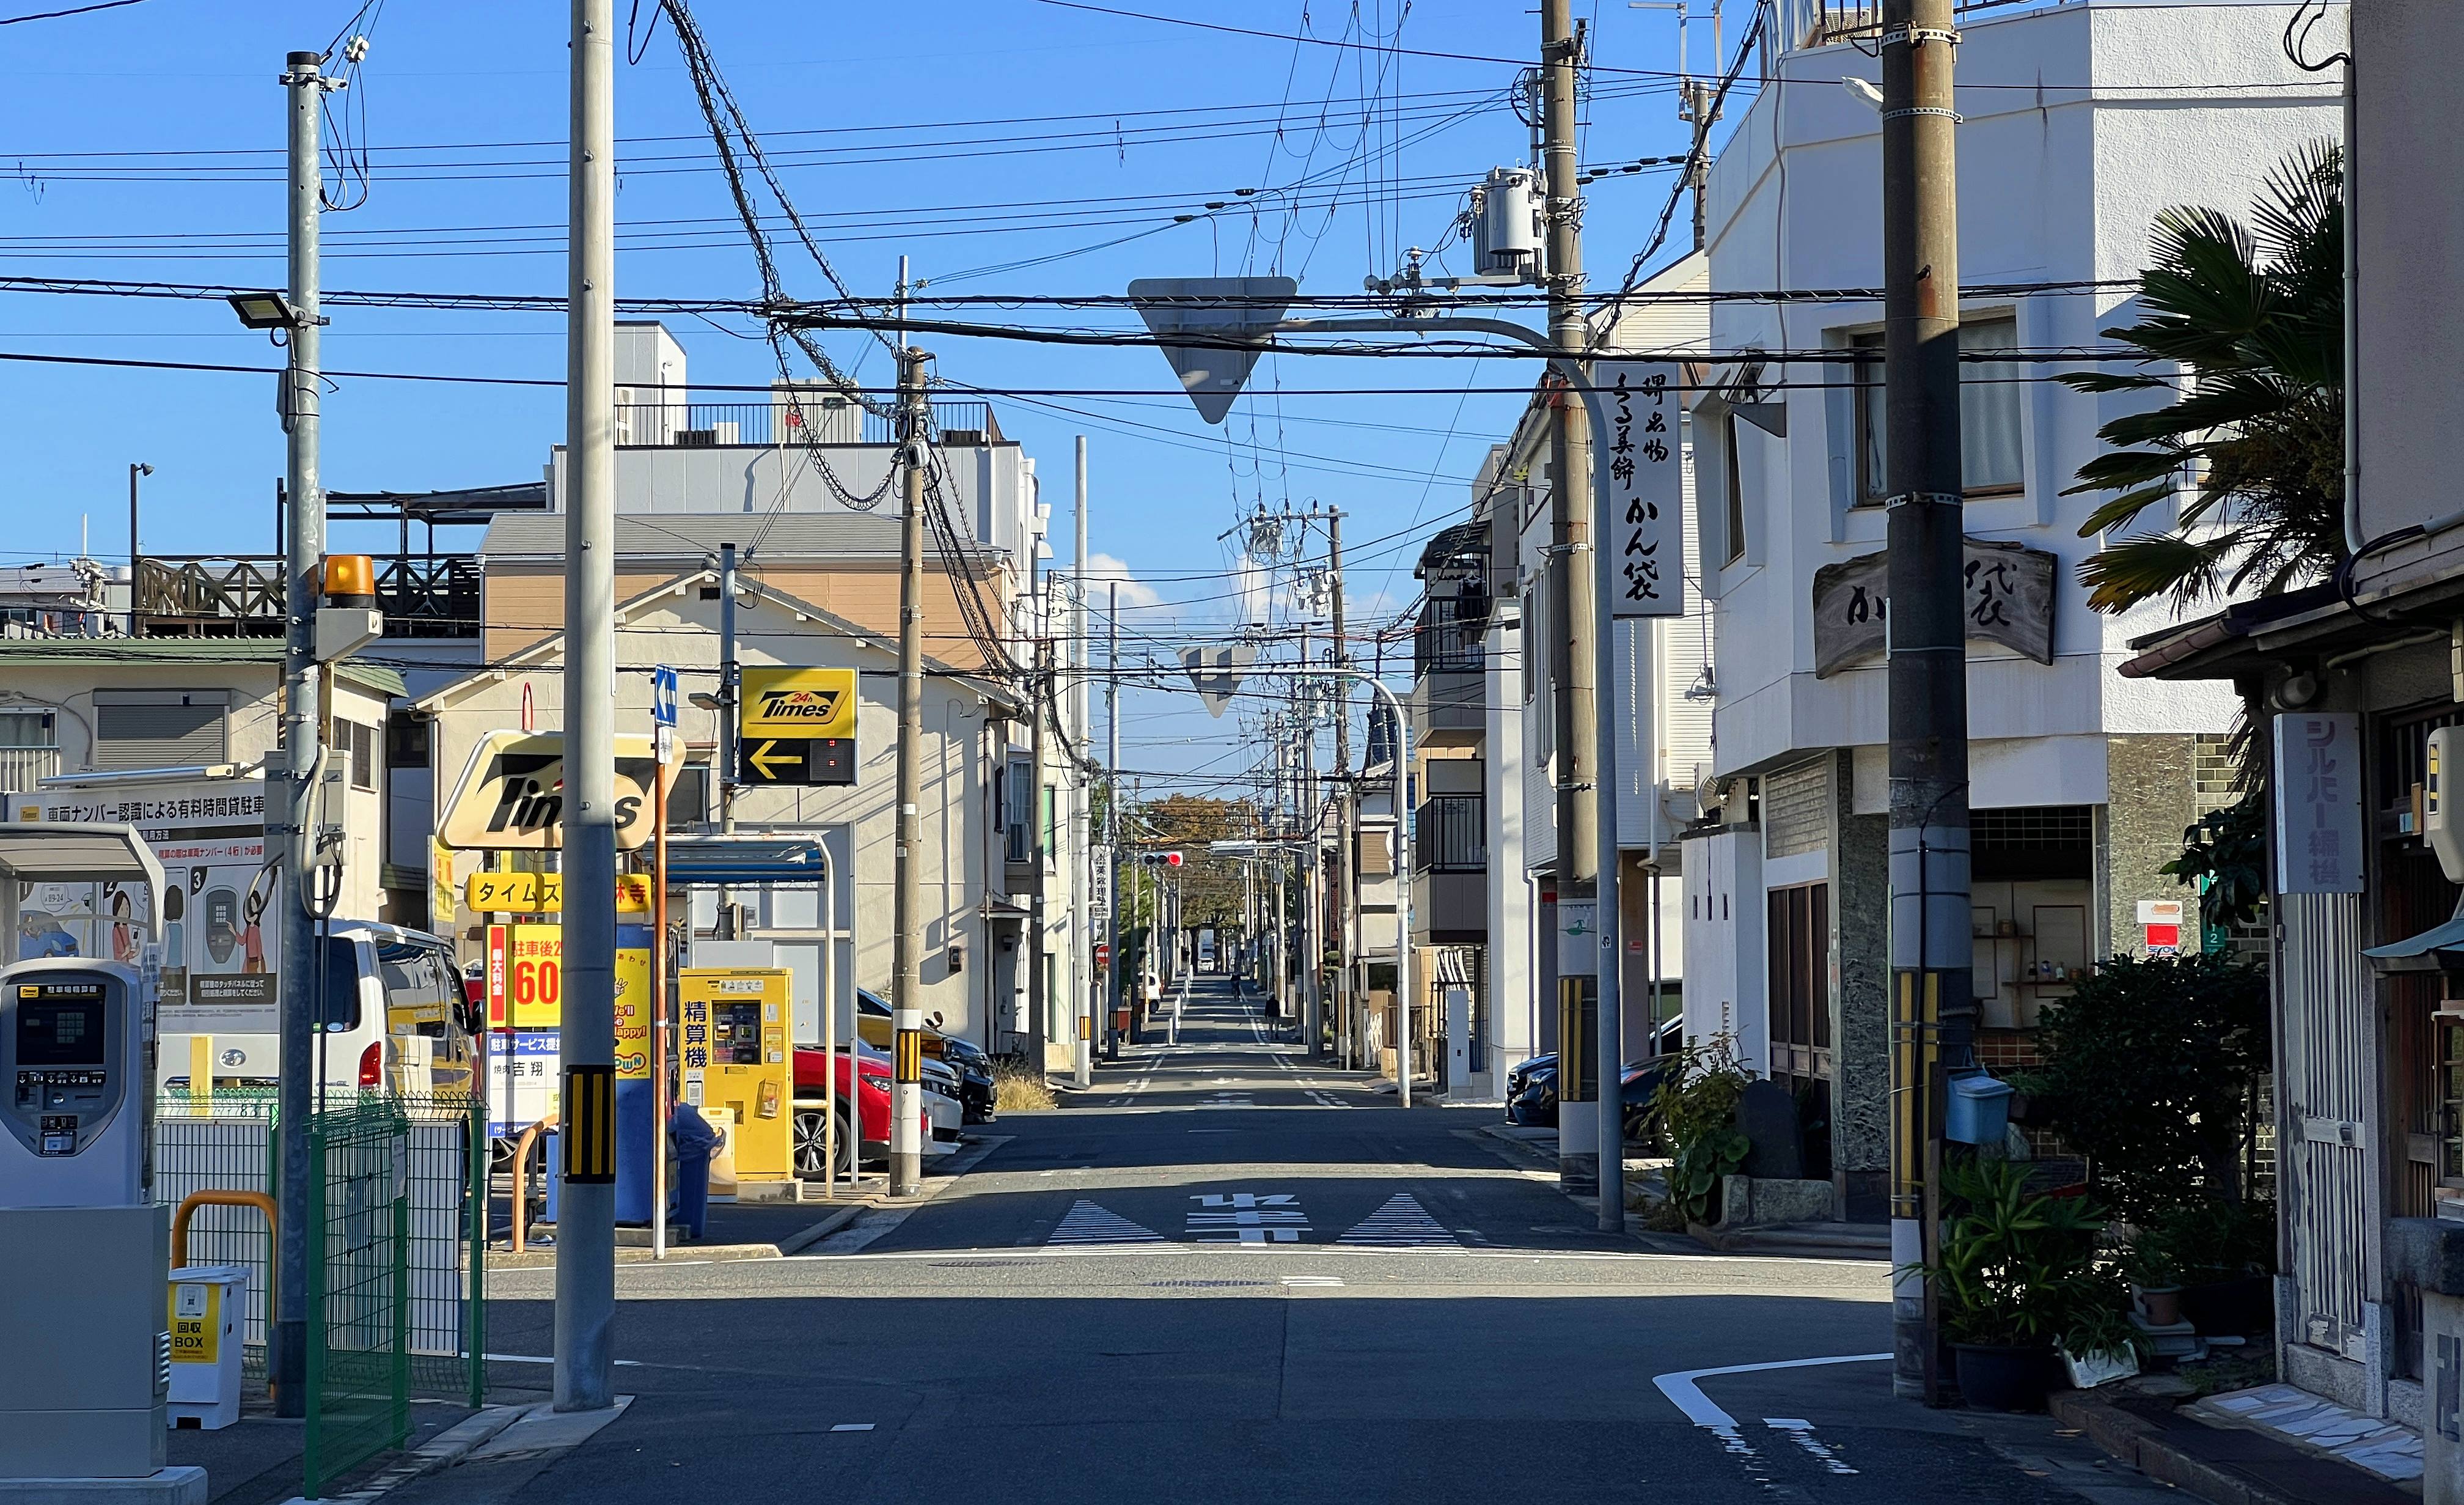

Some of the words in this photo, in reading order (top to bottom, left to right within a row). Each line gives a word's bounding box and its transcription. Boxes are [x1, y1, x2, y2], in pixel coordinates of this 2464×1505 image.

[1623, 496, 1660, 602] かん袋
[762, 699, 831, 718] Times
[485, 777, 642, 833] Tims
[193, 871, 202, 889] 3
[479, 882, 561, 903] タイムズ
[2210, 933, 2218, 943] 2
[684, 1001, 707, 1069] 精算機
[615, 1057, 642, 1069] OWN
[177, 1322, 202, 1334] 回収
[175, 1337, 204, 1349] BOX
